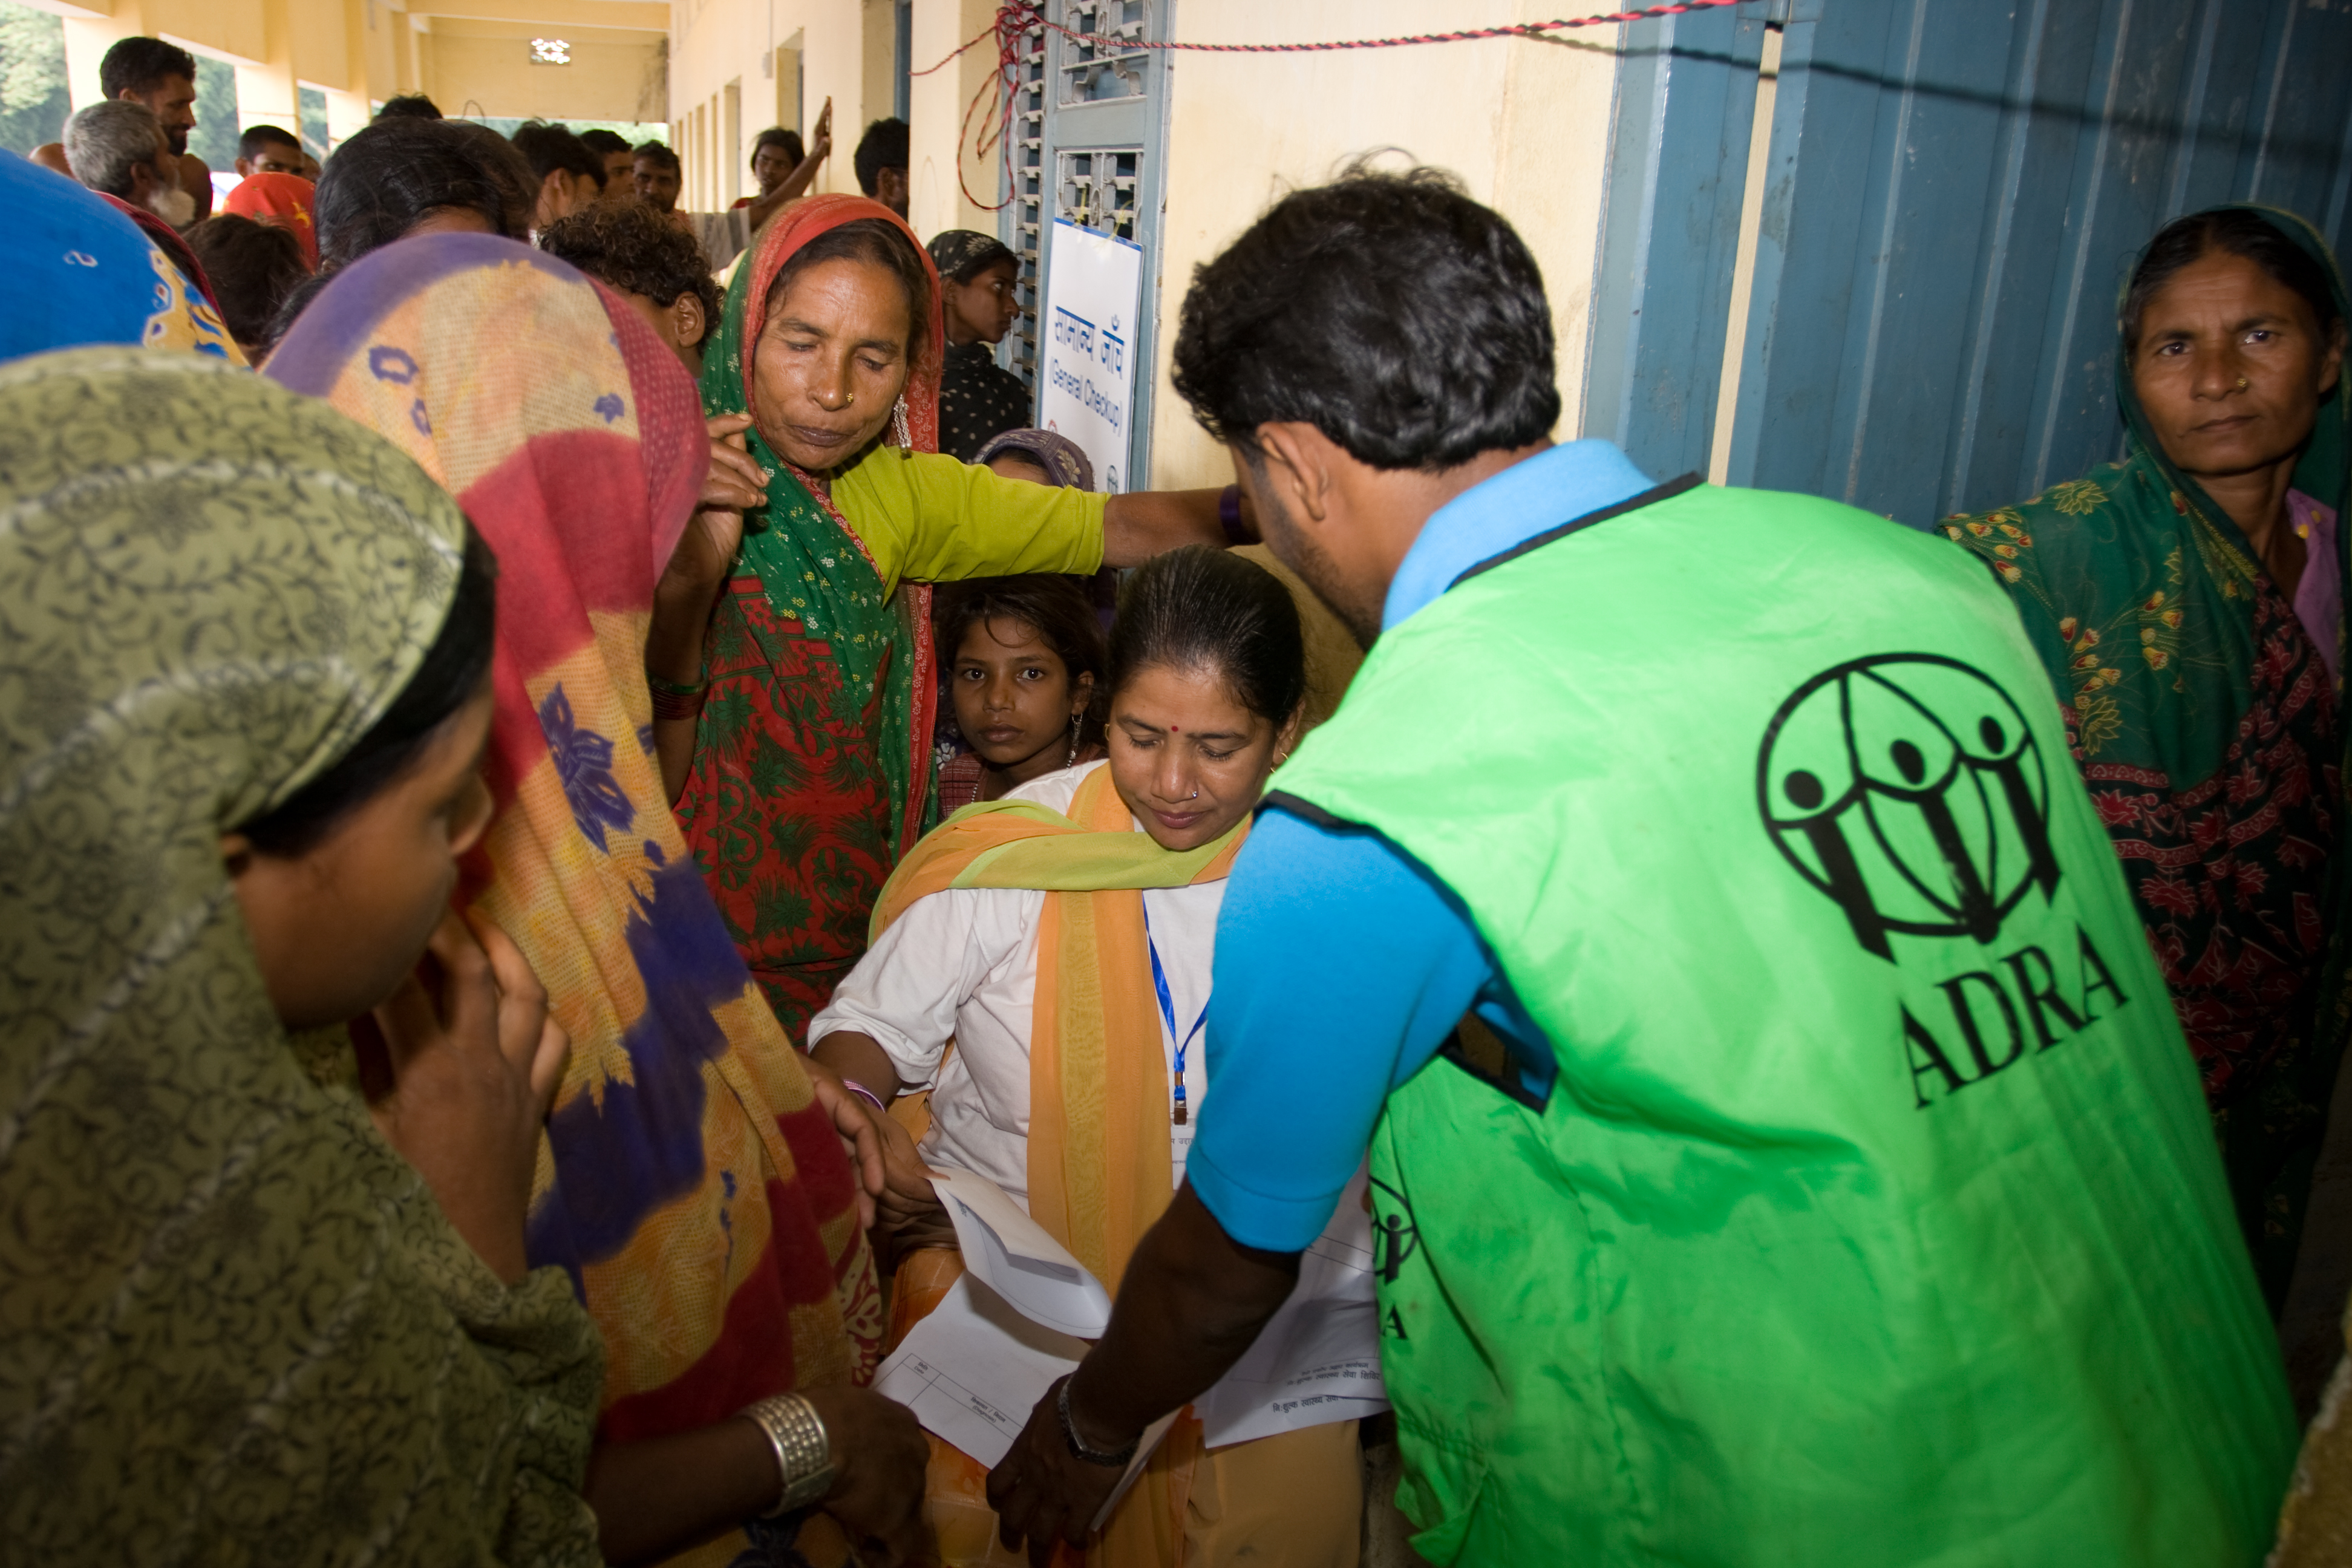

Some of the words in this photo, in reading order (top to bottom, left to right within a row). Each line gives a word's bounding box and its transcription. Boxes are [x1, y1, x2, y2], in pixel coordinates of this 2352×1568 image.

[1054, 305, 1096, 361] सामान्य
[1100, 314, 1125, 379] जाँच
[1049, 356, 1083, 401] (General
[1085, 378, 1123, 437] Checkup)
[1898, 920, 2131, 1110] ADRA
[1342, 1369, 1356, 1379] सेवा
[972, 1405, 996, 1423] (Diagnosis)
[1301, 1396, 1323, 1406] स्वास्थ्य
